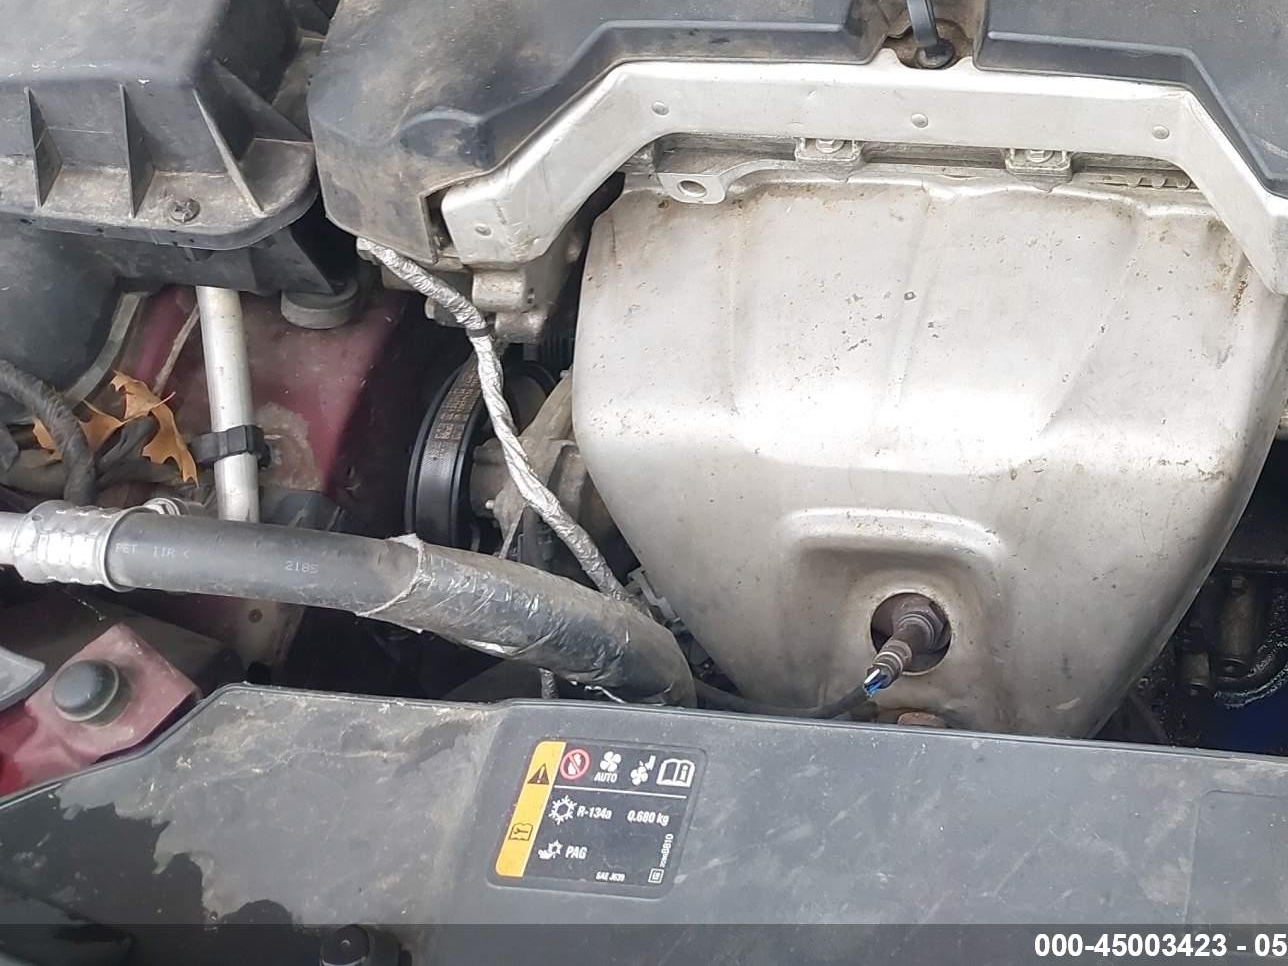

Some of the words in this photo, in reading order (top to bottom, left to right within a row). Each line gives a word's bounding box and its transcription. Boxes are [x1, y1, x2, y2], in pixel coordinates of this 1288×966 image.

[594, 772, 619, 784] AUTO
[576, 805, 613, 820] R-134a
[627, 809, 656, 824] 0.680
[656, 811, 670, 827] kg
[565, 845, 588, 860] PAG
